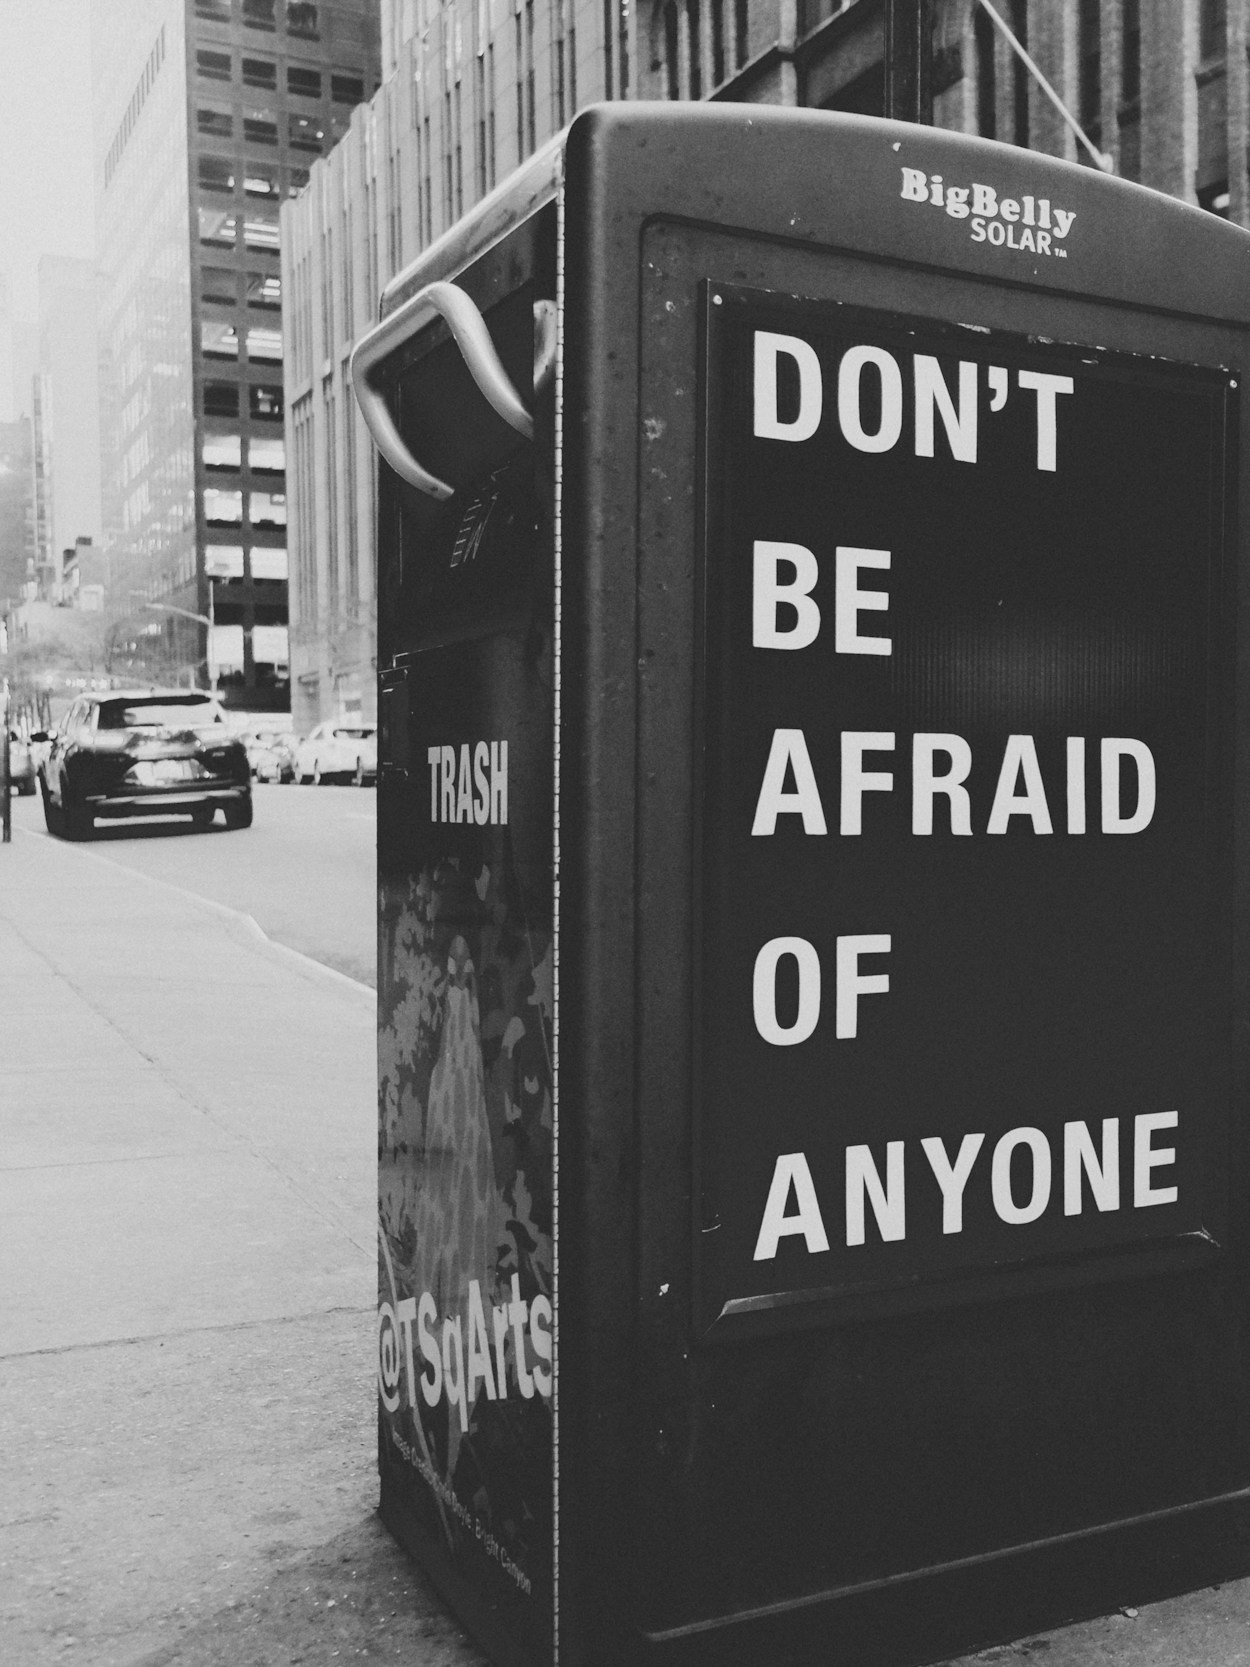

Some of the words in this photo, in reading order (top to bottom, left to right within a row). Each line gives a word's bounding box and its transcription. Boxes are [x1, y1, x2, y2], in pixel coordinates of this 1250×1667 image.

[900, 167, 1077, 239] BigBelly
[970, 217, 1052, 256] SOLAR
[752, 540, 892, 656] BE
[428, 740, 509, 826] TRASH
[751, 728, 1157, 836] AFRAID
[752, 934, 892, 1046] OF
[753, 1110, 1179, 1261] ANYONE
[378, 1273, 553, 1433] @TSqArts
